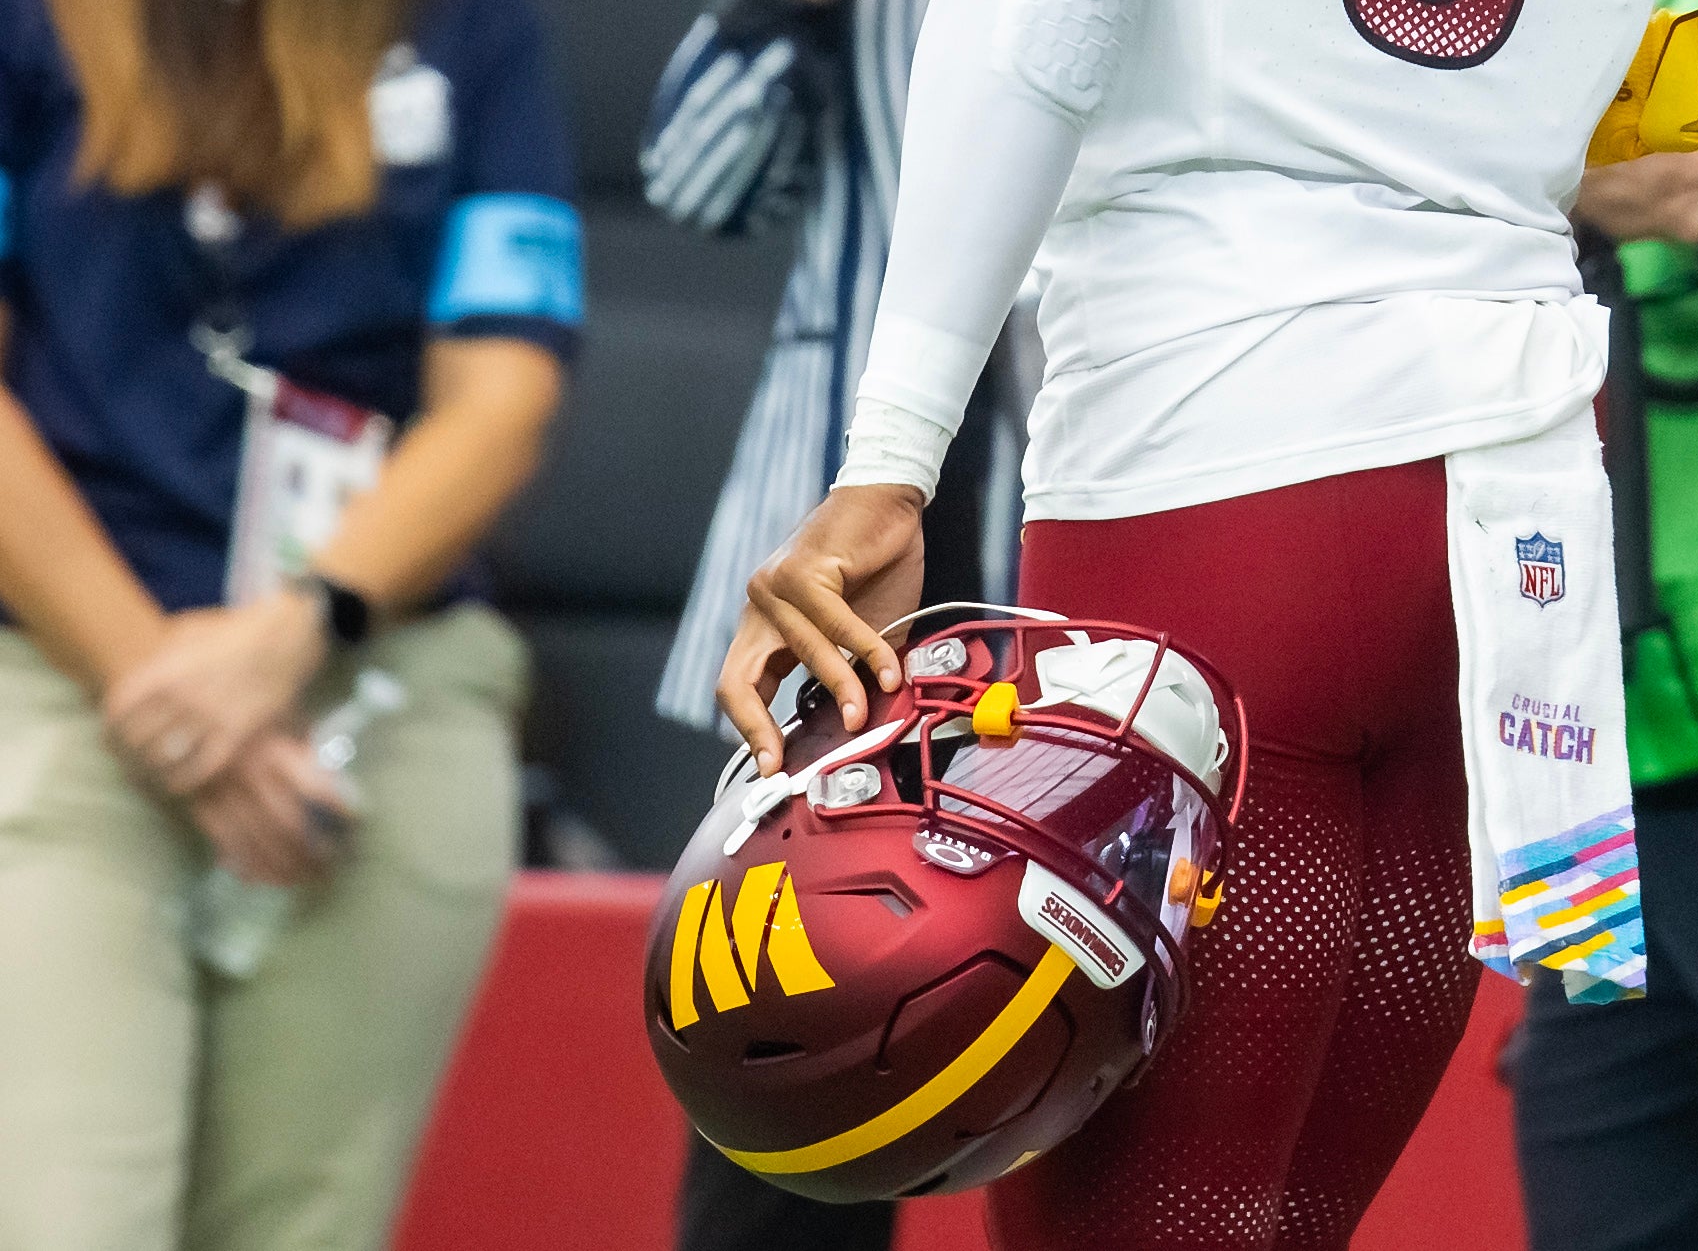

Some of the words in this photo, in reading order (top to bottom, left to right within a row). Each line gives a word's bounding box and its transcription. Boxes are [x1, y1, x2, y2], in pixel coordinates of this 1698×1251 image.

[1522, 563, 1561, 601] NFL
[1511, 693, 1581, 723] CRUCIAL
[1499, 711, 1597, 765] CATCH
[916, 828, 993, 863] OAKLEY
[1040, 896, 1126, 978] COMMANDERS
